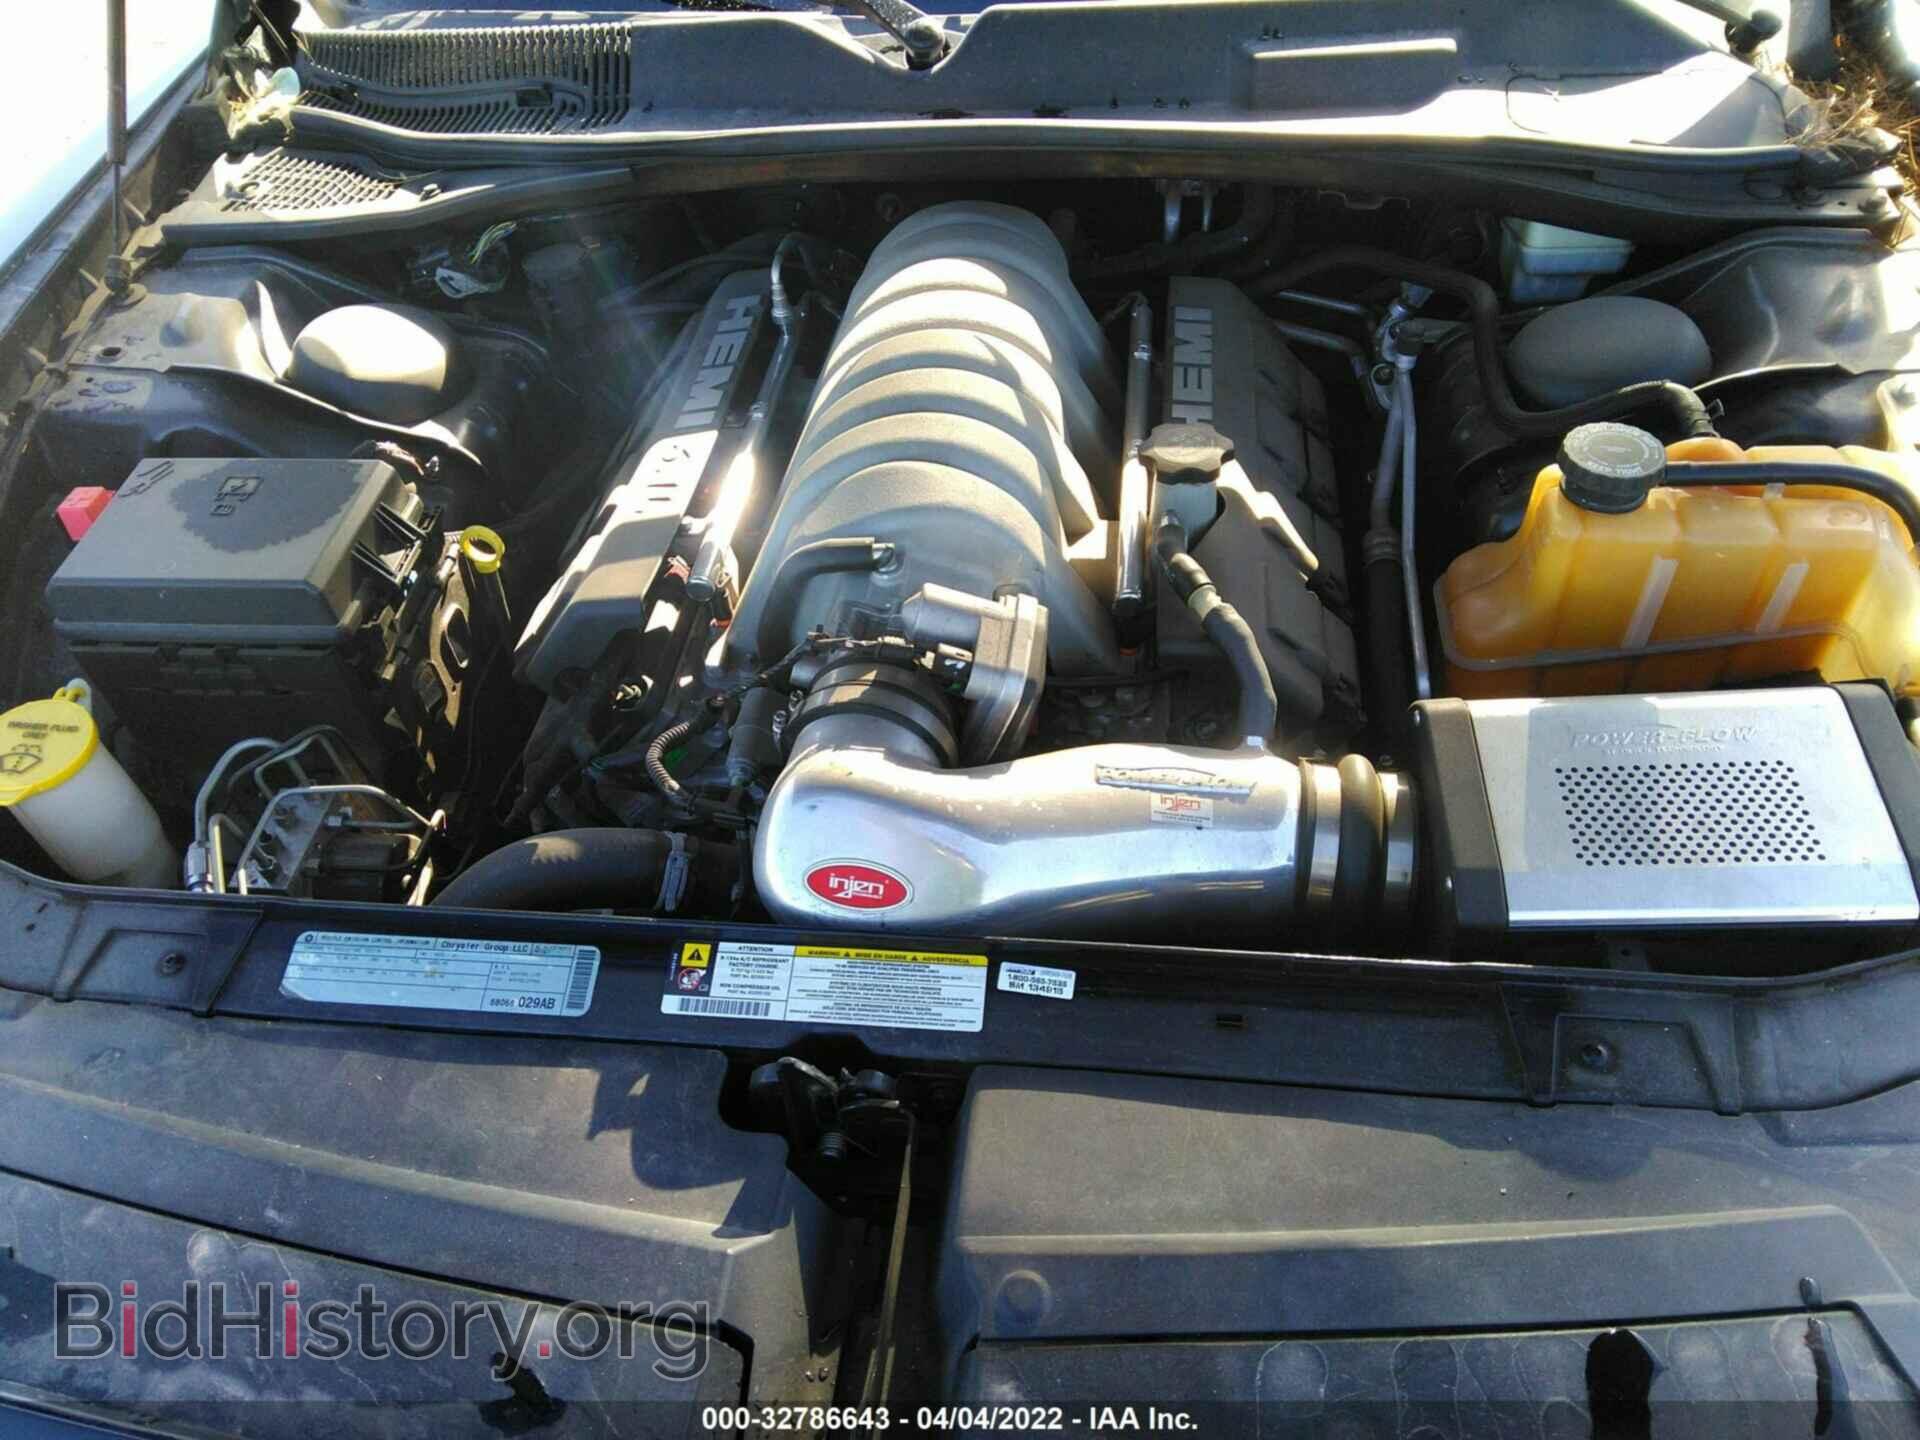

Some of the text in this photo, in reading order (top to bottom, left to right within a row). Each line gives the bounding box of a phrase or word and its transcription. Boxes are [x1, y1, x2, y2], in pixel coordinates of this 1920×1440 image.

[674, 295, 760, 429] HEMI
[829, 872, 884, 899] injen
[441, 941, 479, 951] Chrysler
[484, 944, 509, 953] Group
[512, 944, 528, 953] LLC
[738, 945, 773, 953] ATTENTION
[518, 997, 556, 1010] 029AB
